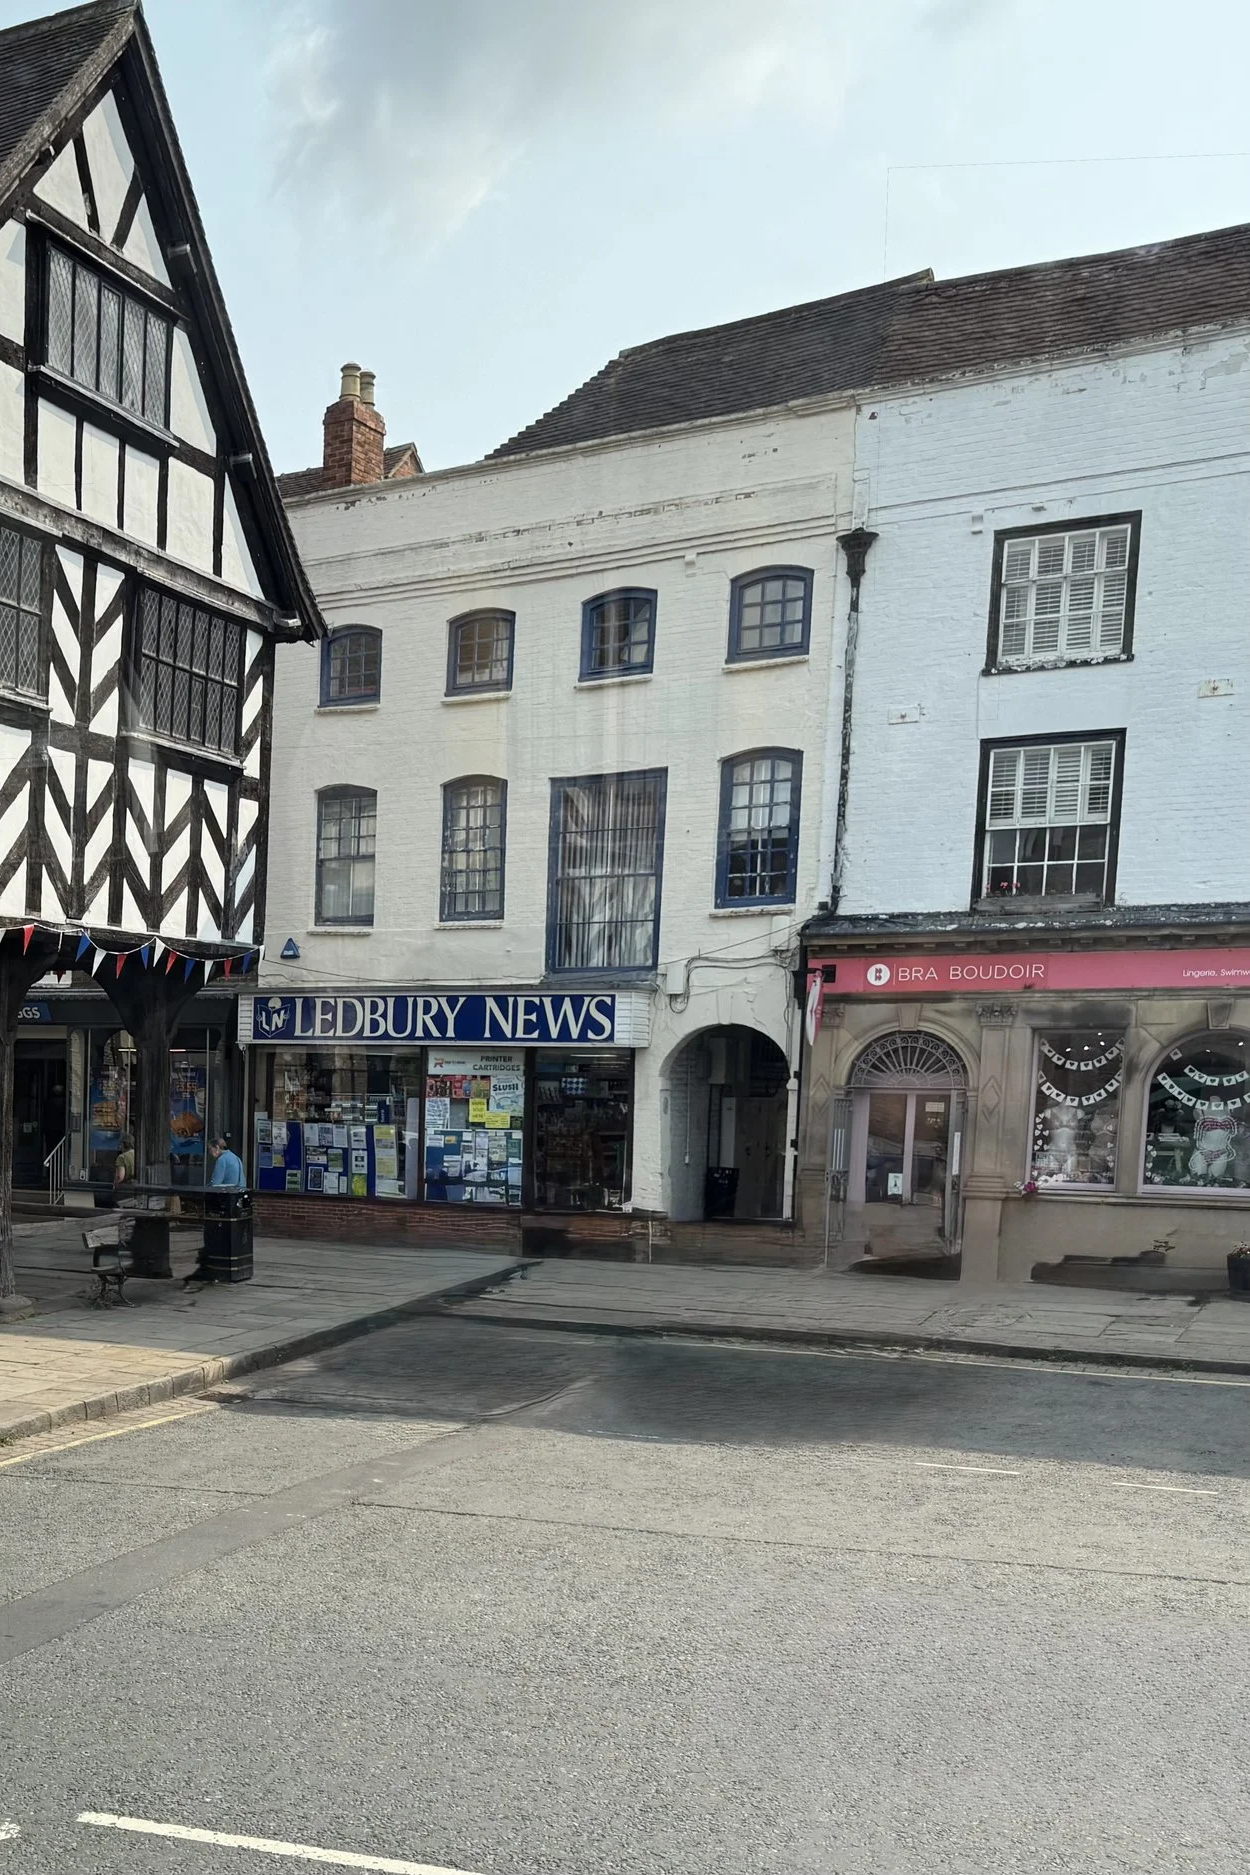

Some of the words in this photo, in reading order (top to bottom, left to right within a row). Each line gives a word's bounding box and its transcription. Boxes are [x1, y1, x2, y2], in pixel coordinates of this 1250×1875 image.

[898, 967, 938, 981] BRA
[949, 964, 1045, 980] BOUDOIR
[294, 996, 467, 1038] LEDBURY
[483, 996, 613, 1040] NEWS
[480, 1055, 513, 1063] PRINTER
[472, 1064, 521, 1072] CARTRIDGES
[492, 1083, 519, 1092] SLUSH
